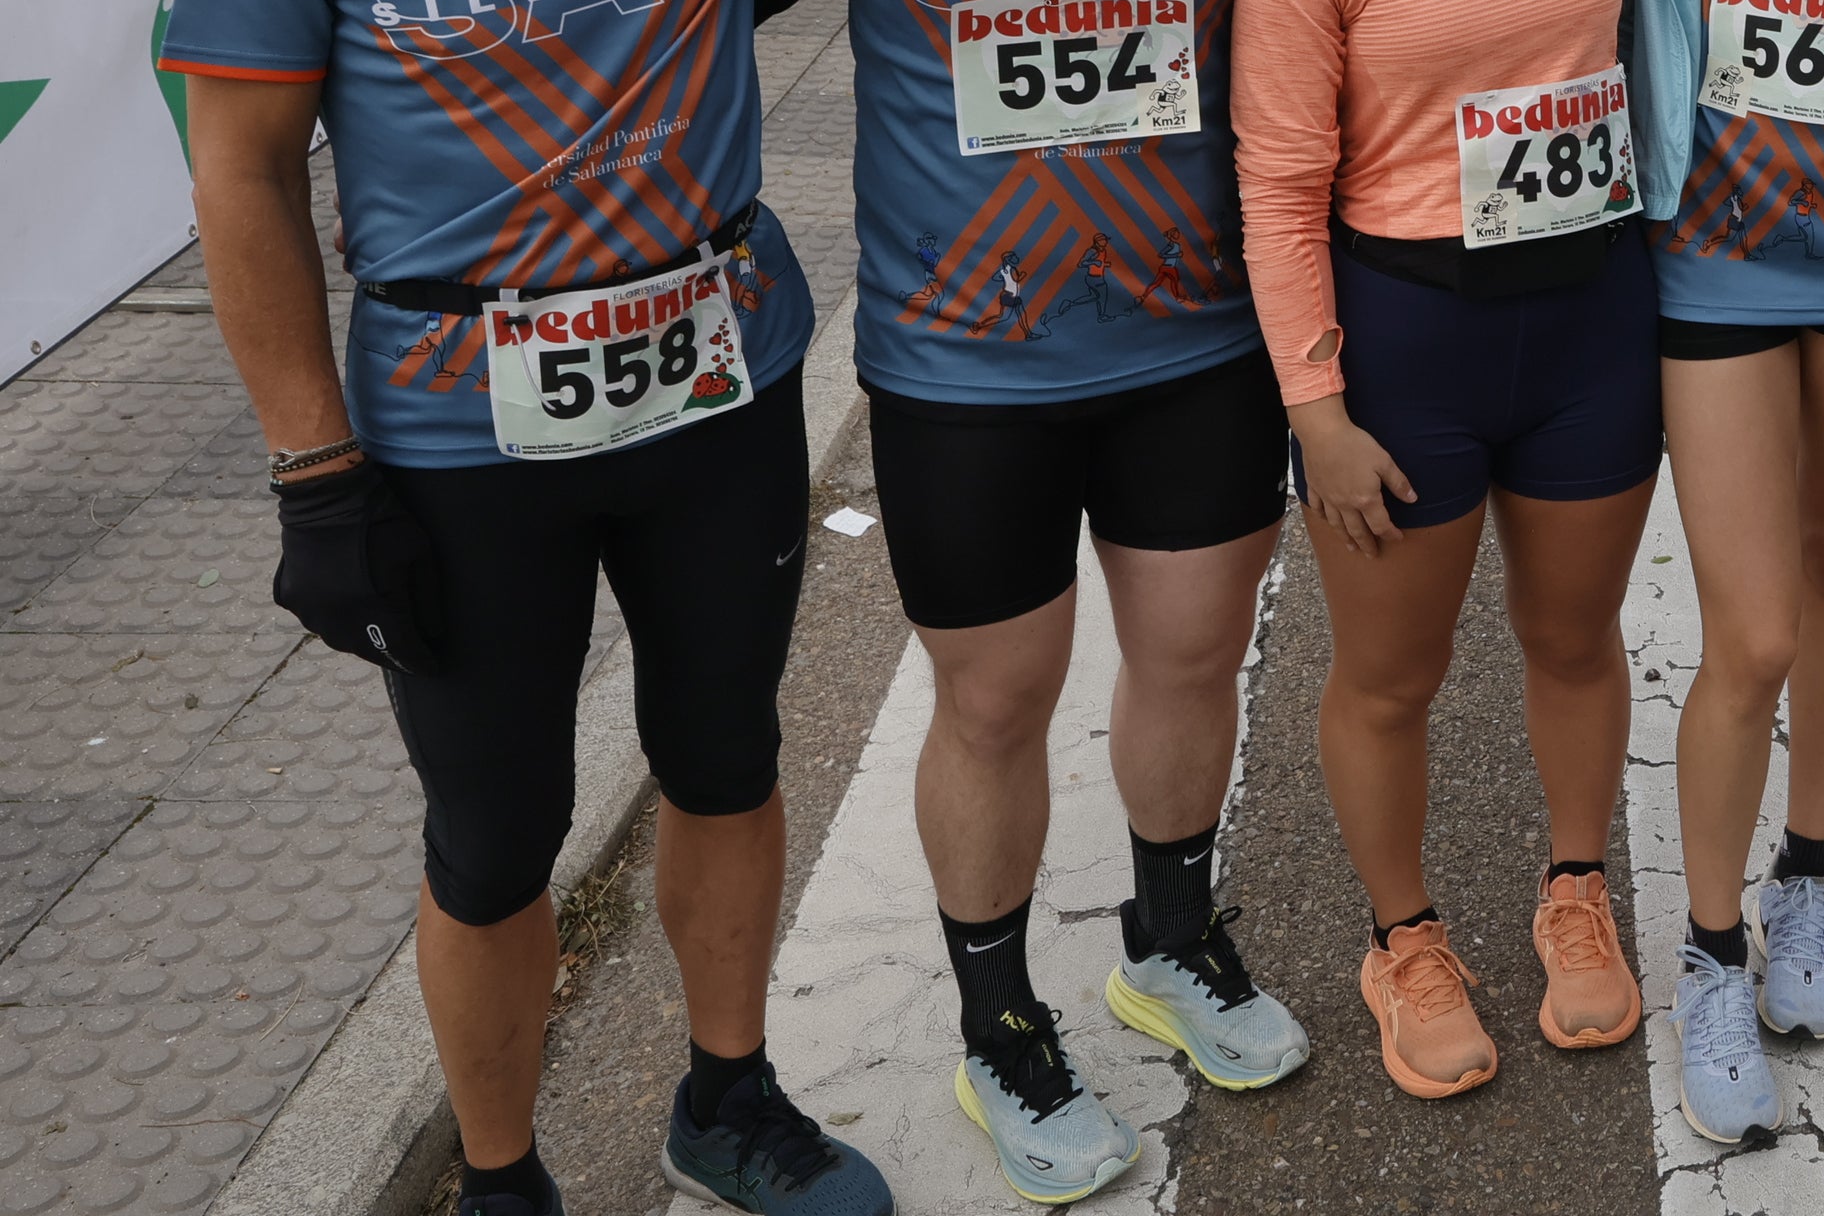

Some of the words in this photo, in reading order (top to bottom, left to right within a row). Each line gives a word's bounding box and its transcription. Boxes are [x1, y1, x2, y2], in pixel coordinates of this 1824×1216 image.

[996, 31, 1156, 110] 554
[1462, 79, 1626, 140] bedunia
[1710, 89, 1738, 106] Km21
[614, 113, 691, 148] Pontificia
[1152, 115, 1186, 127] Km21
[543, 173, 565, 190] de
[568, 147, 663, 184] Salamanca
[1034, 146, 1056, 160] de
[1057, 143, 1141, 159] Salamanca
[1497, 123, 1614, 203] 483
[1476, 225, 1506, 238] Km21
[613, 274, 683, 302] FLORISTERÍAS
[492, 272, 721, 347] bedunia
[539, 317, 698, 420] 558
